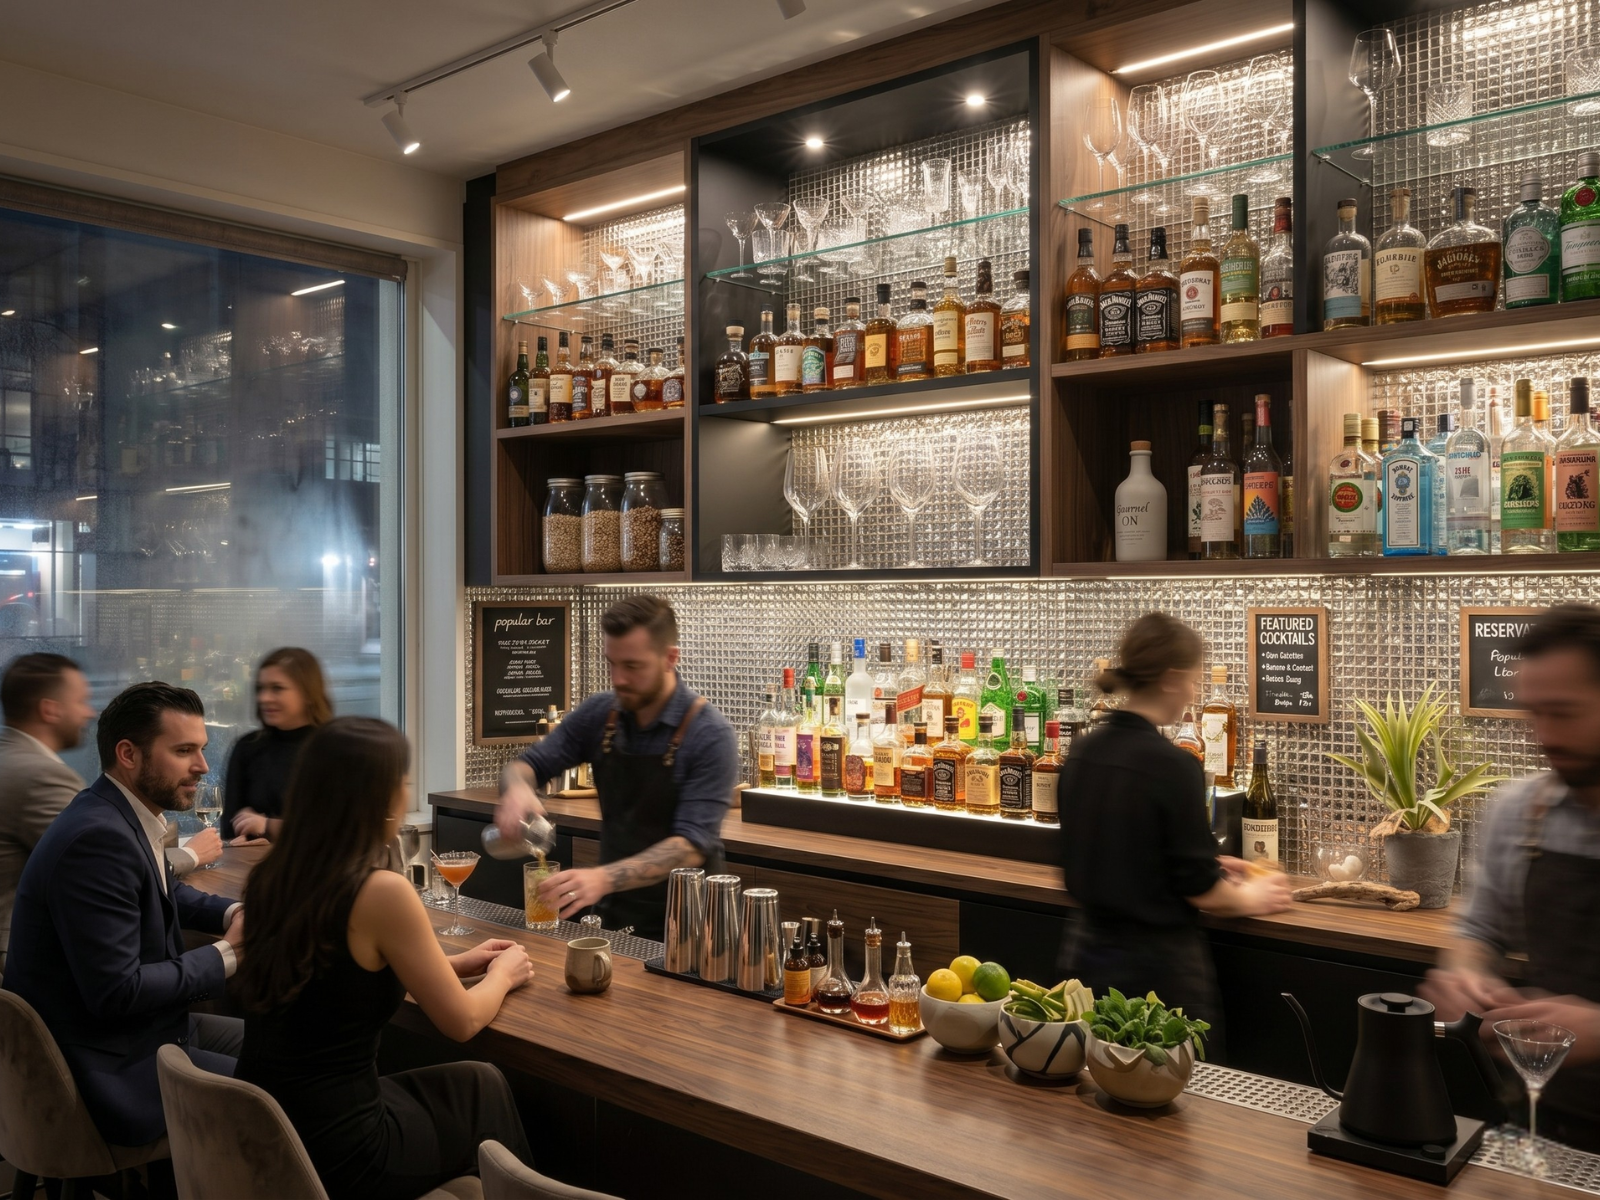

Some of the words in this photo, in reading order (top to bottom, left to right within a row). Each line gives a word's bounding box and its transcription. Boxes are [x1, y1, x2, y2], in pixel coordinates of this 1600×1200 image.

[1122, 516, 1138, 527] ON
[494, 612, 533, 632] popular
[536, 612, 555, 626] bar
[1260, 617, 1314, 631] FEATURED
[1475, 622, 1536, 638] RESERVA
[1260, 632, 1315, 645] COCKTAILS
